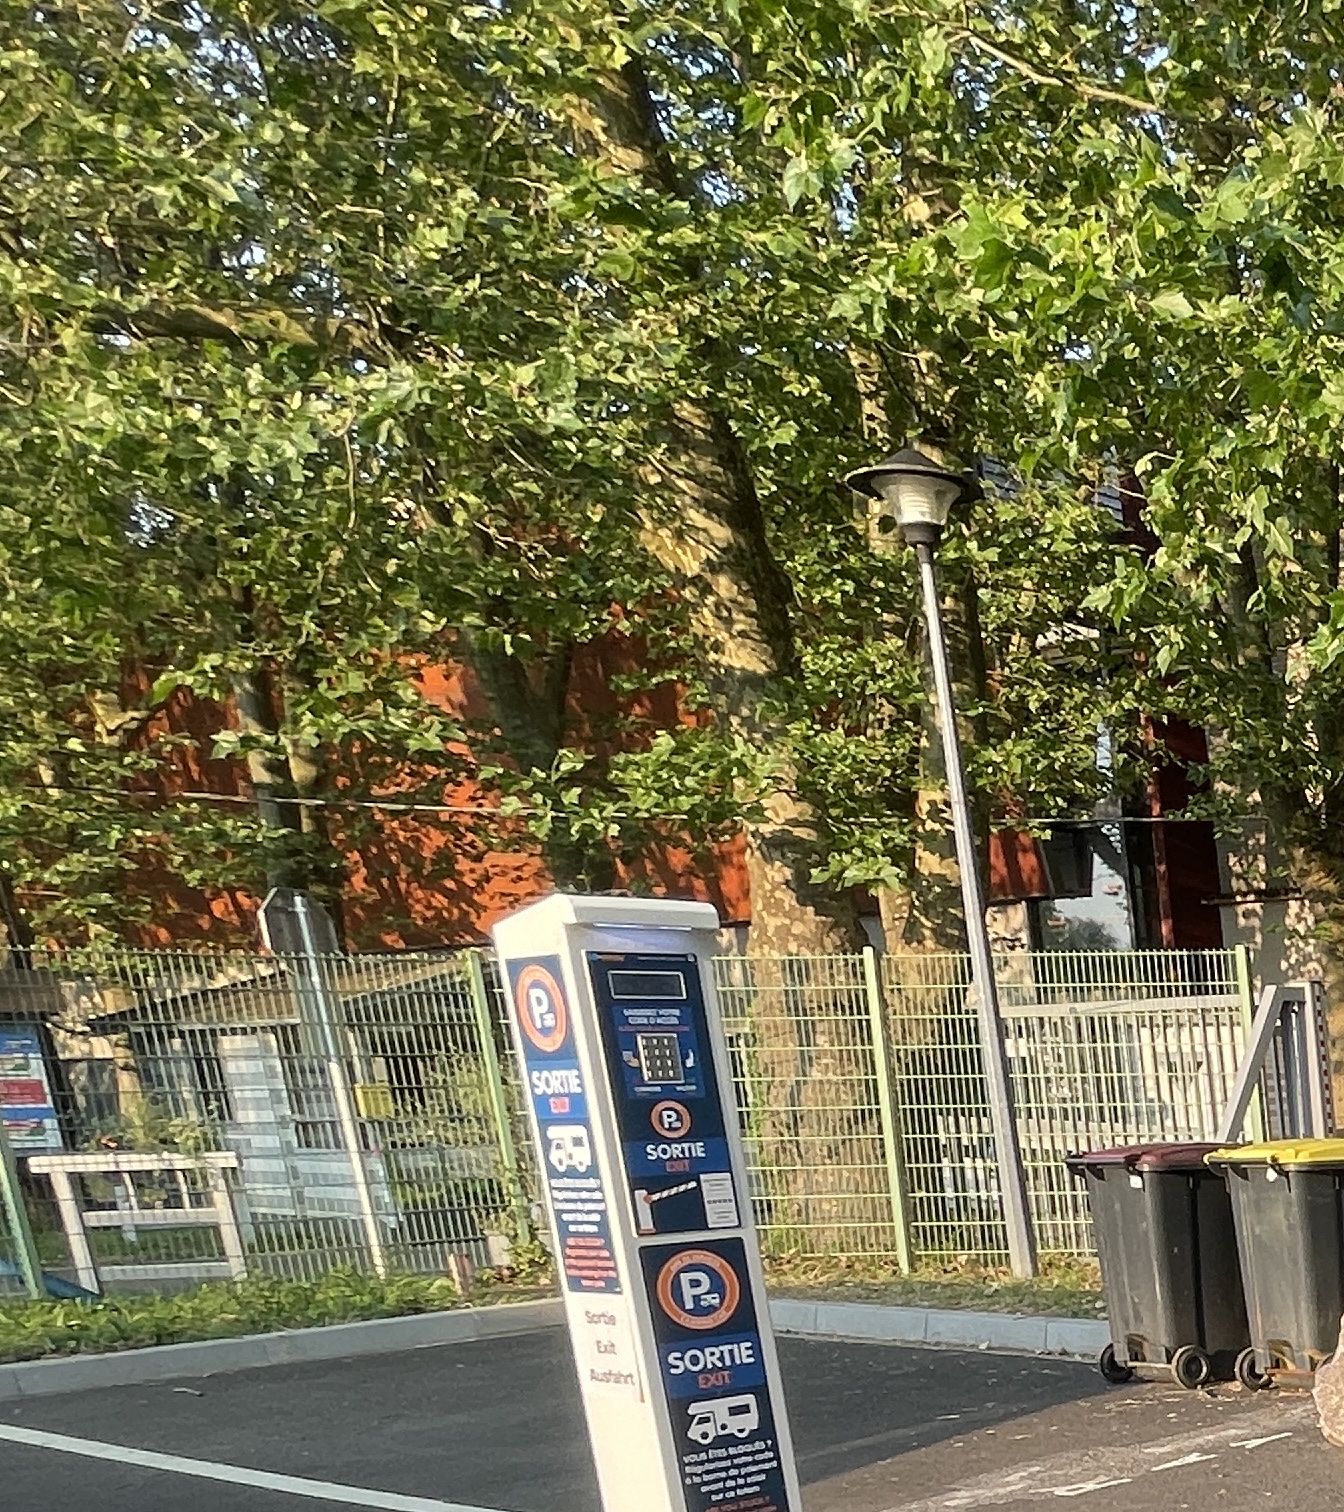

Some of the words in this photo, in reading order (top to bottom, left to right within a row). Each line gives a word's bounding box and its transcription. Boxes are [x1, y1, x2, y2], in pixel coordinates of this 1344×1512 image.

[529, 989, 549, 1029] P
[530, 1069, 582, 1095] SORTIE
[661, 1110, 678, 1129] P
[645, 1142, 706, 1160] SORTIE
[680, 1271, 710, 1310] P
[585, 1310, 616, 1326] Sortie
[596, 1340, 617, 1355] Exit
[667, 1341, 755, 1375] SORTIE
[590, 1368, 635, 1386] Ausfahrt
[698, 1370, 731, 1389] EXIT
[683, 1452, 708, 1463] VOUS
